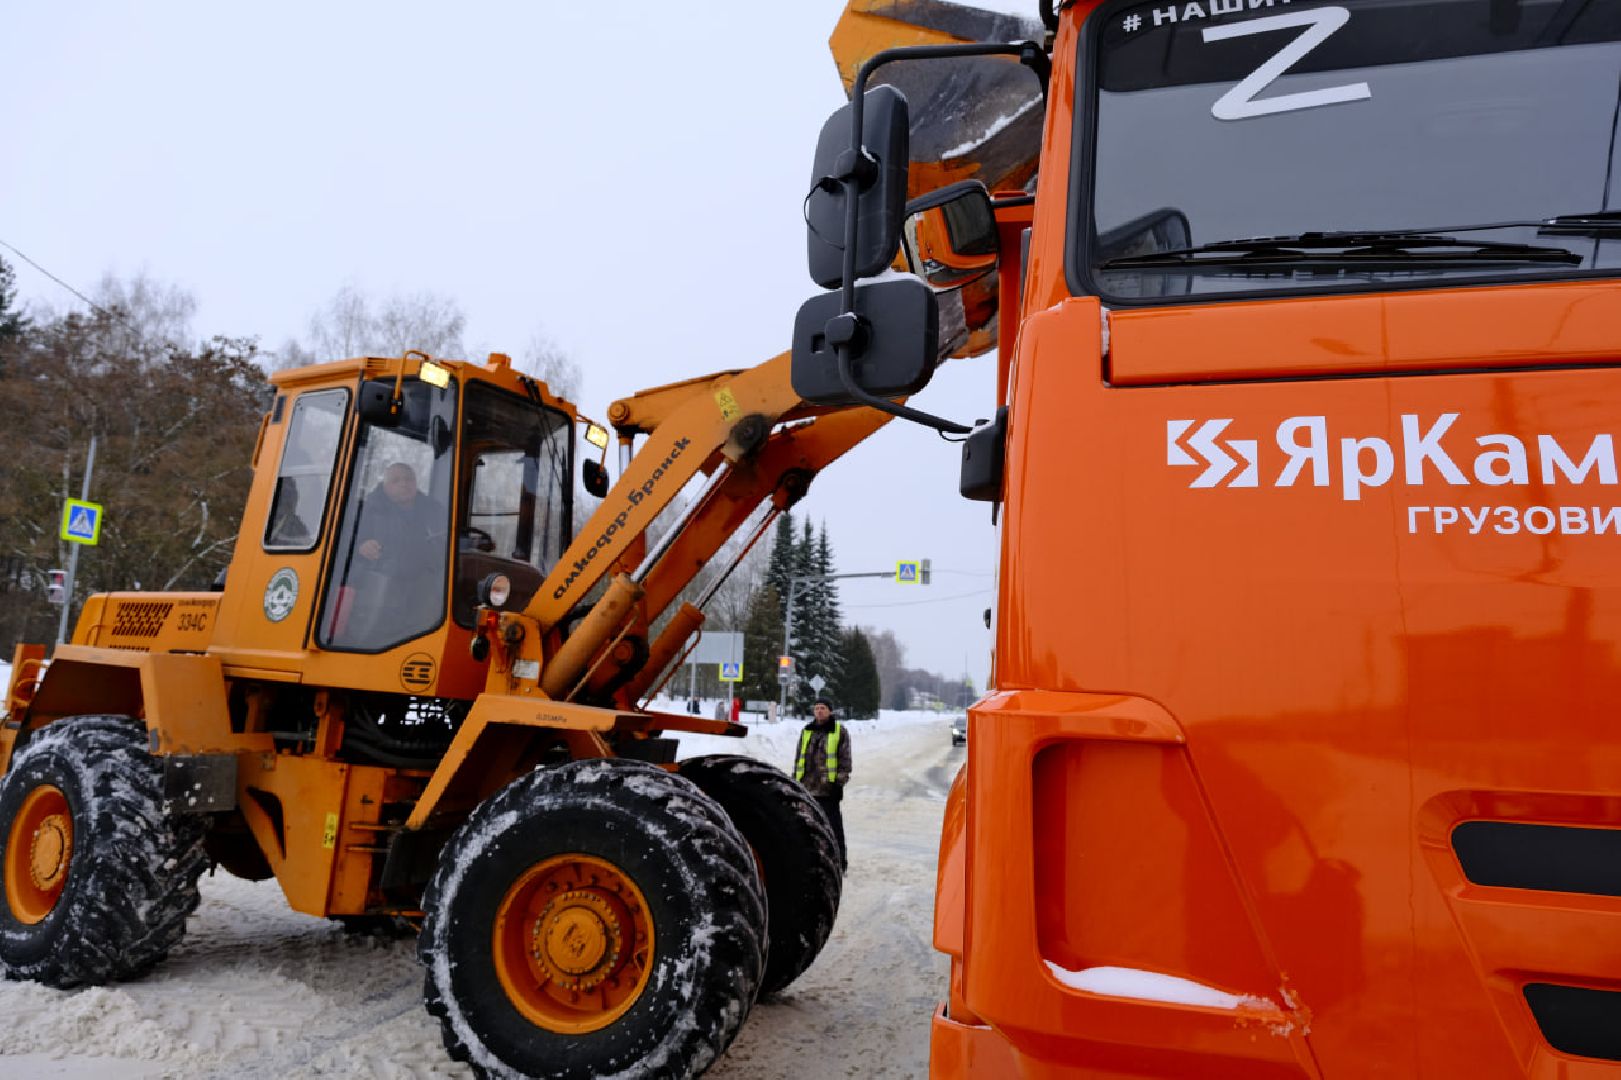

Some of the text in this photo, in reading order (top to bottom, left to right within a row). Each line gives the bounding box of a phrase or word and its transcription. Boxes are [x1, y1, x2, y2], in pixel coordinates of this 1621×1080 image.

[1202, 6, 1371, 120] Z
[1274, 412, 1619, 500] ЯрКам
[1407, 506, 1621, 535] ГРУЗОВИ
